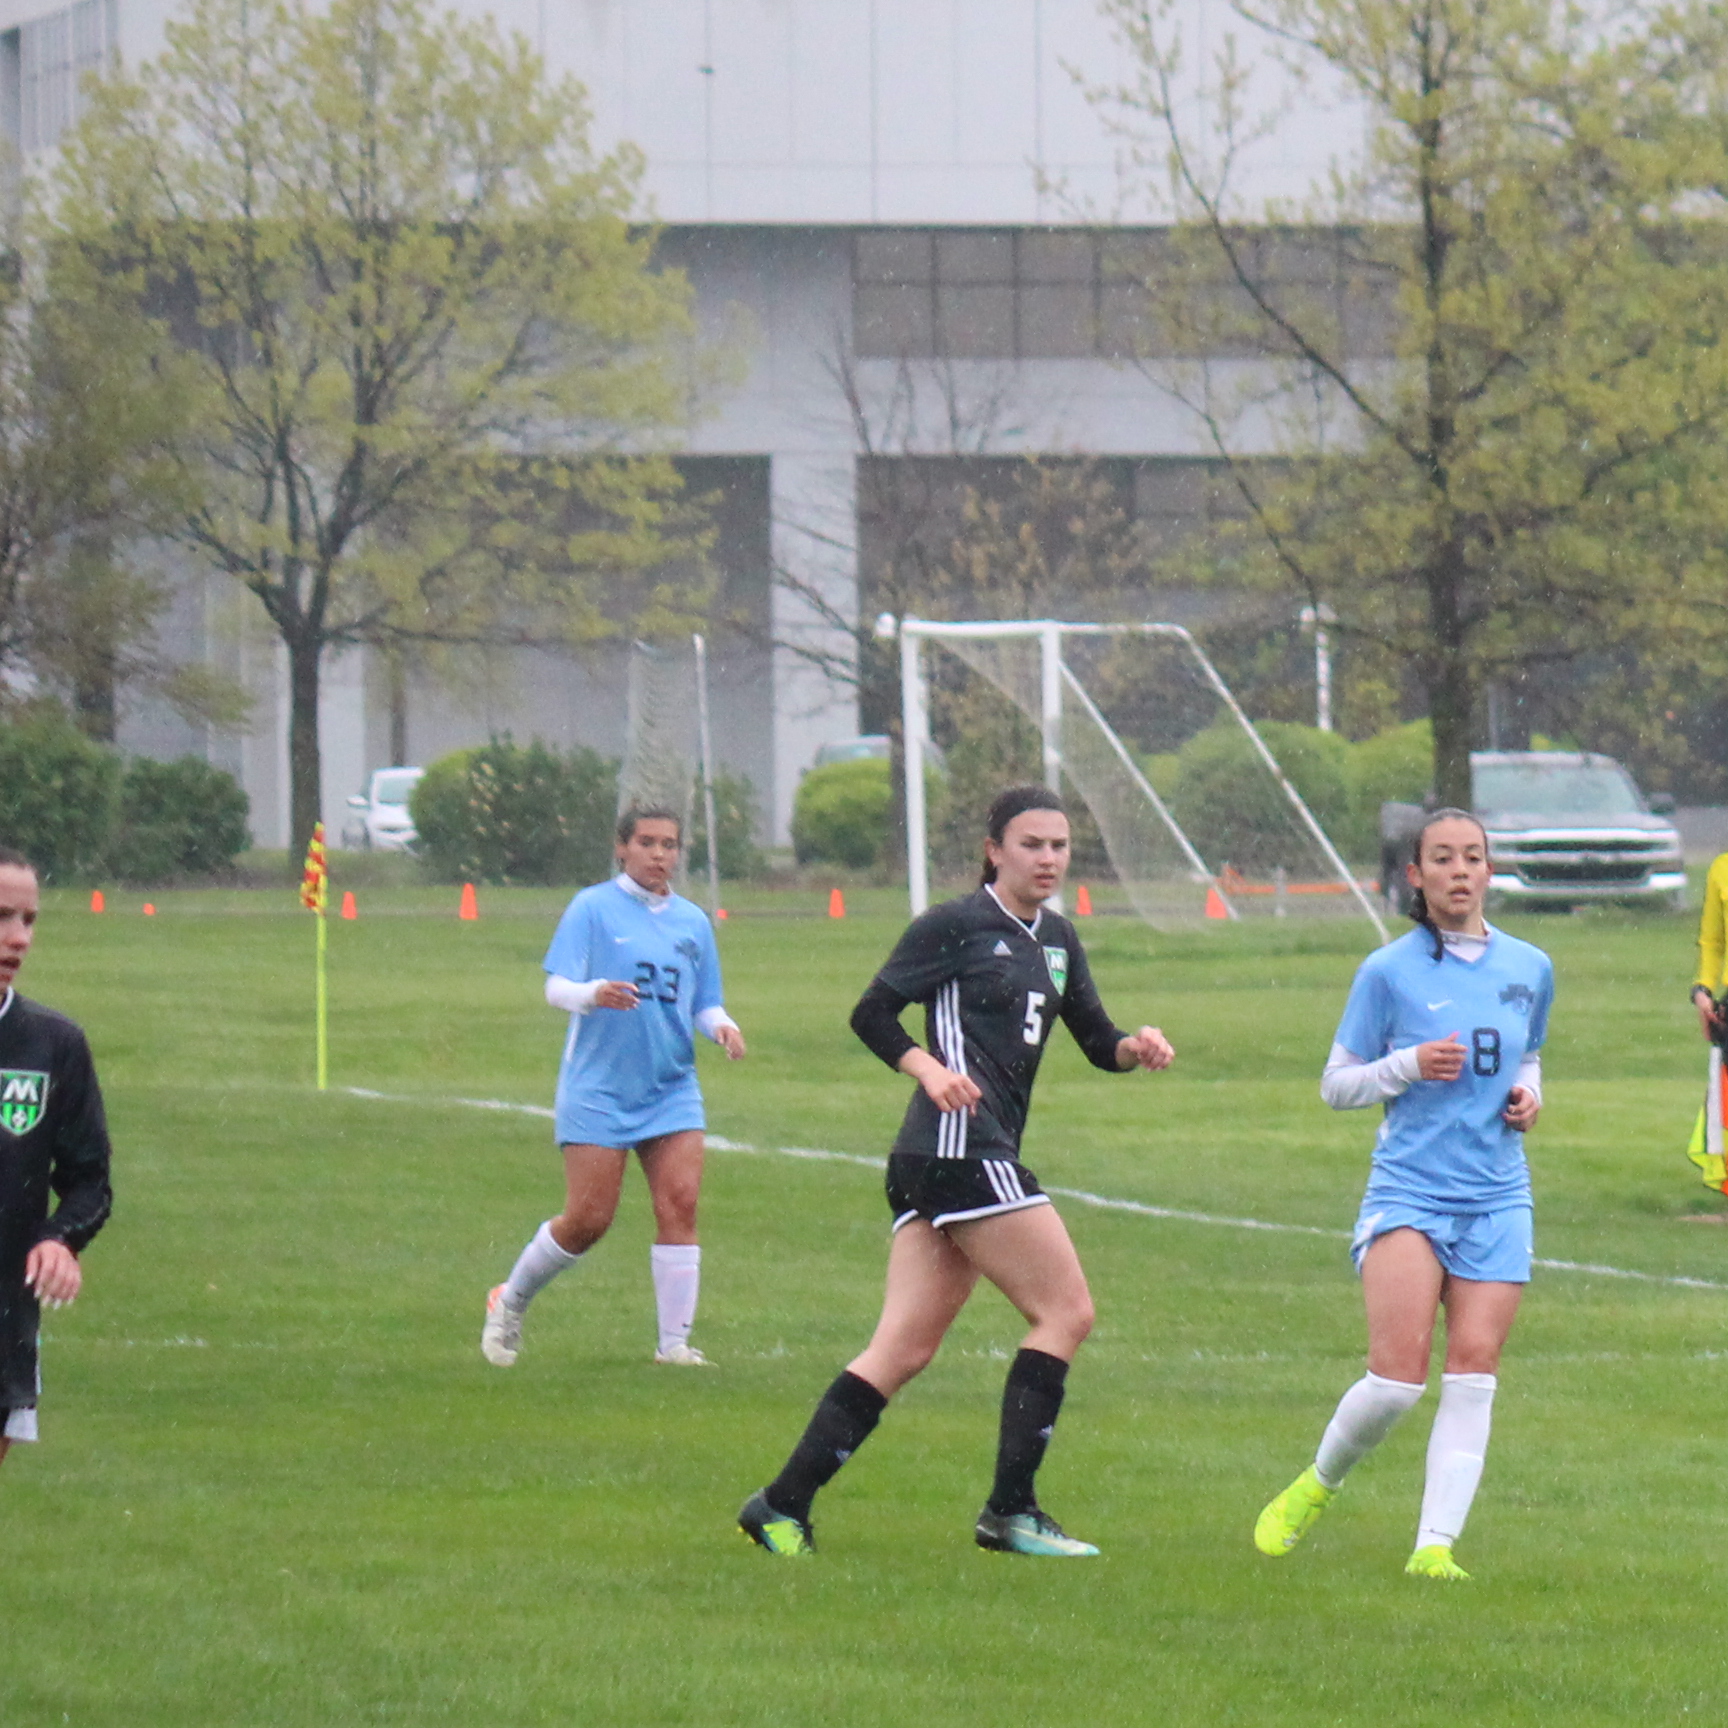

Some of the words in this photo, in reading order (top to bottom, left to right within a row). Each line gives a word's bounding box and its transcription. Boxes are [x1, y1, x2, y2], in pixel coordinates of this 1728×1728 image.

[633, 961, 680, 1003] 23
[1023, 991, 1046, 1046] 5
[1472, 1027, 1501, 1077] 8
[3, 1079, 39, 1102] M
